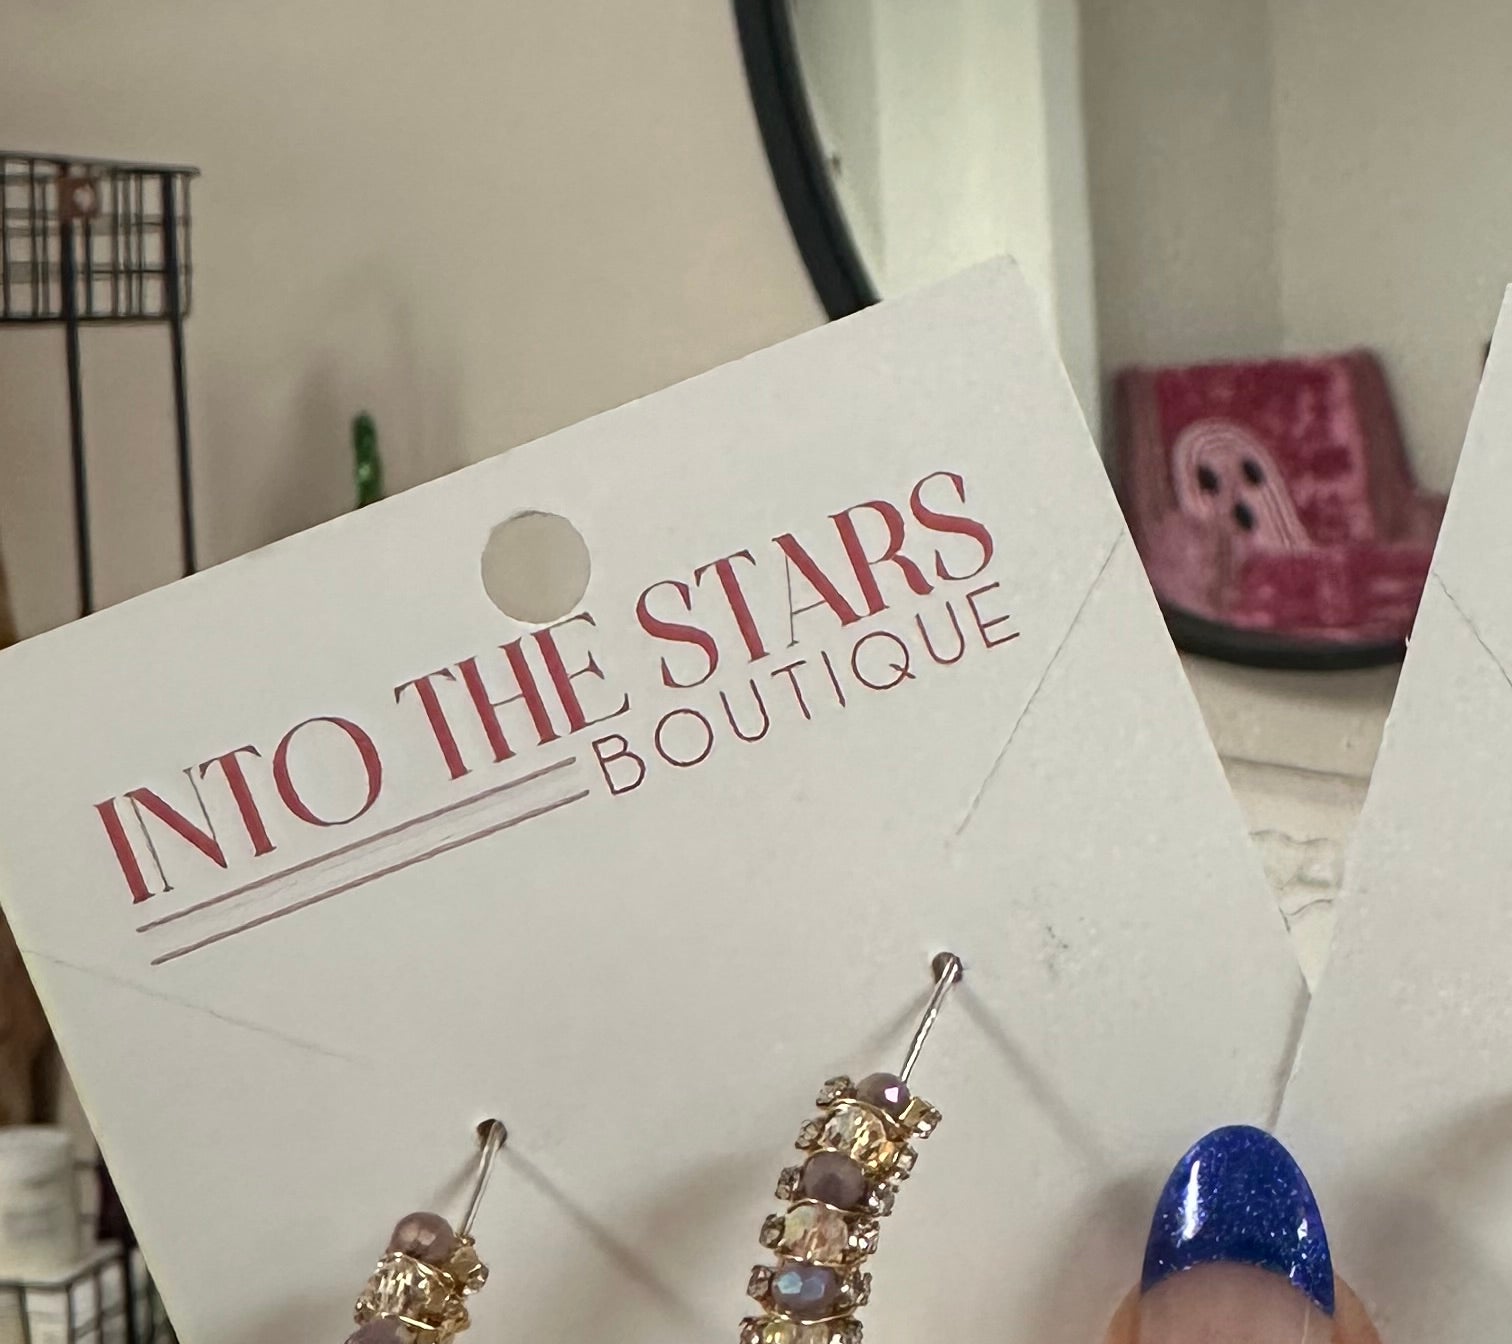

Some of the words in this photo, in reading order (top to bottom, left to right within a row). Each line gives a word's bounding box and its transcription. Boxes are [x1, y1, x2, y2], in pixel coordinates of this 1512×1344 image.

[92, 715, 384, 905] INTO
[394, 611, 630, 782] THE
[636, 471, 994, 690] STARS
[591, 581, 1020, 796] BOUTIQUE
